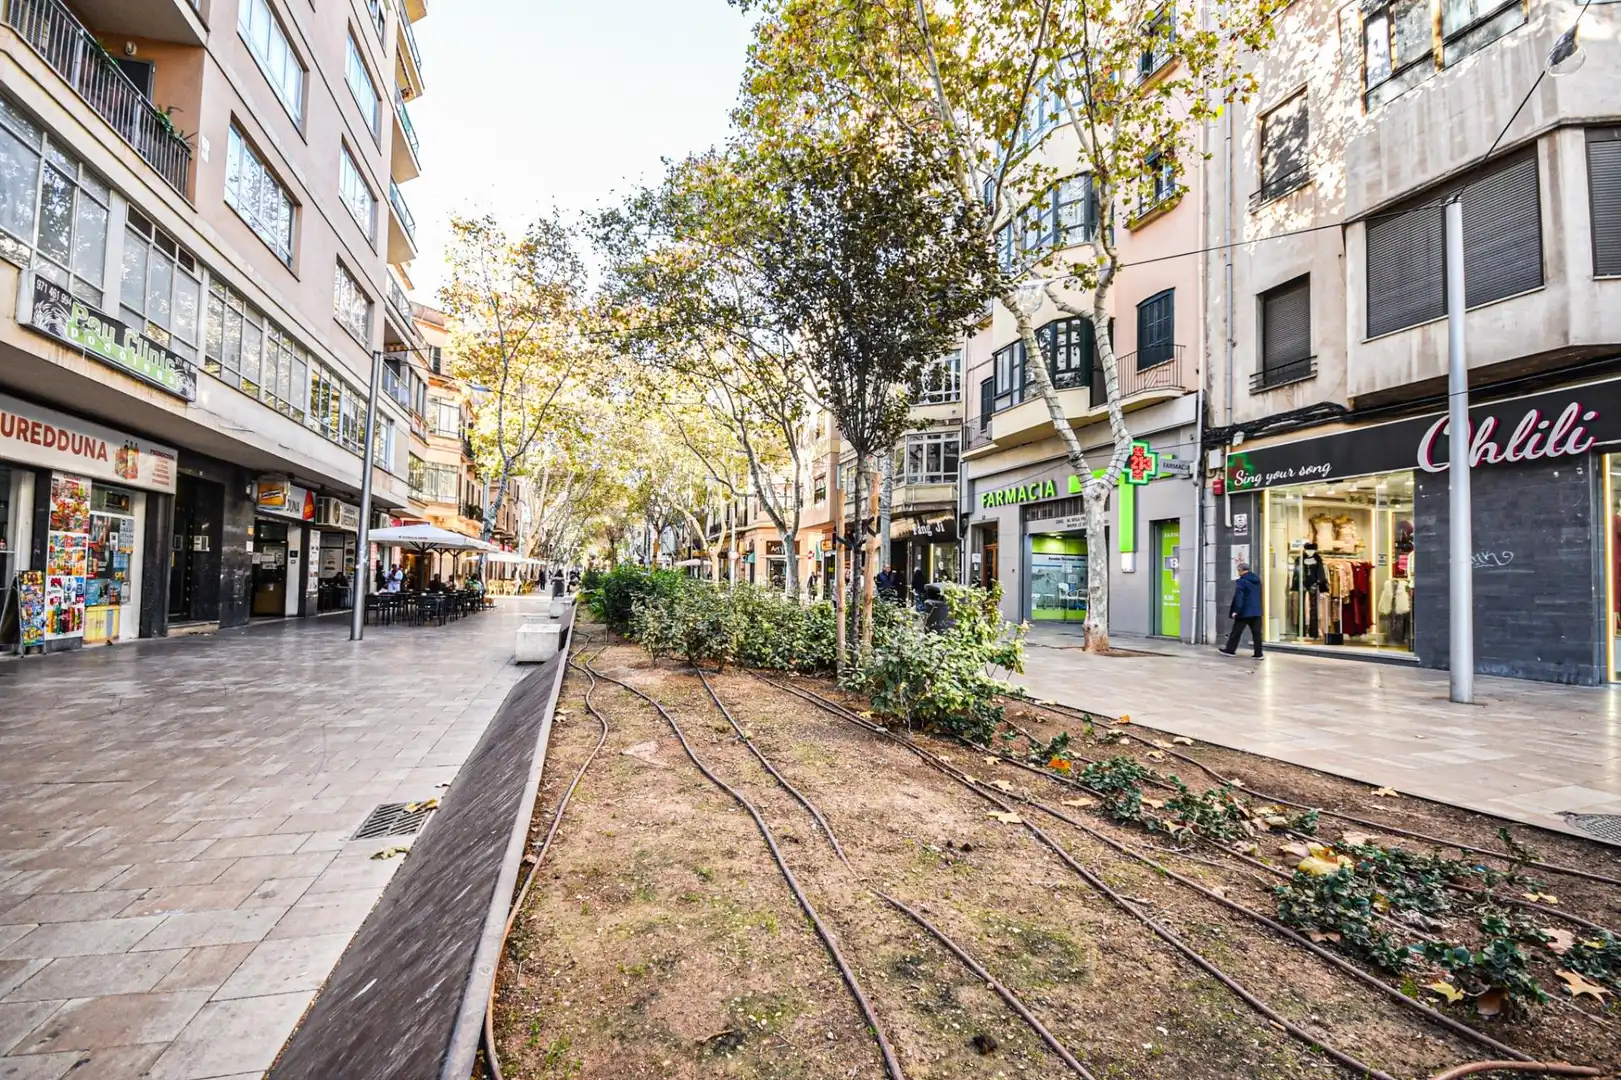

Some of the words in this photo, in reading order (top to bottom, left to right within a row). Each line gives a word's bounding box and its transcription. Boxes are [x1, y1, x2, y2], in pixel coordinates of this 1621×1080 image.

[36, 279, 48, 294] 971
[48, 287, 60, 300] 461
[1233, 469, 1262, 487] Sing
[1265, 467, 1296, 486] your
[1298, 462, 1333, 478] song
[981, 479, 1057, 509] FARMACIA
